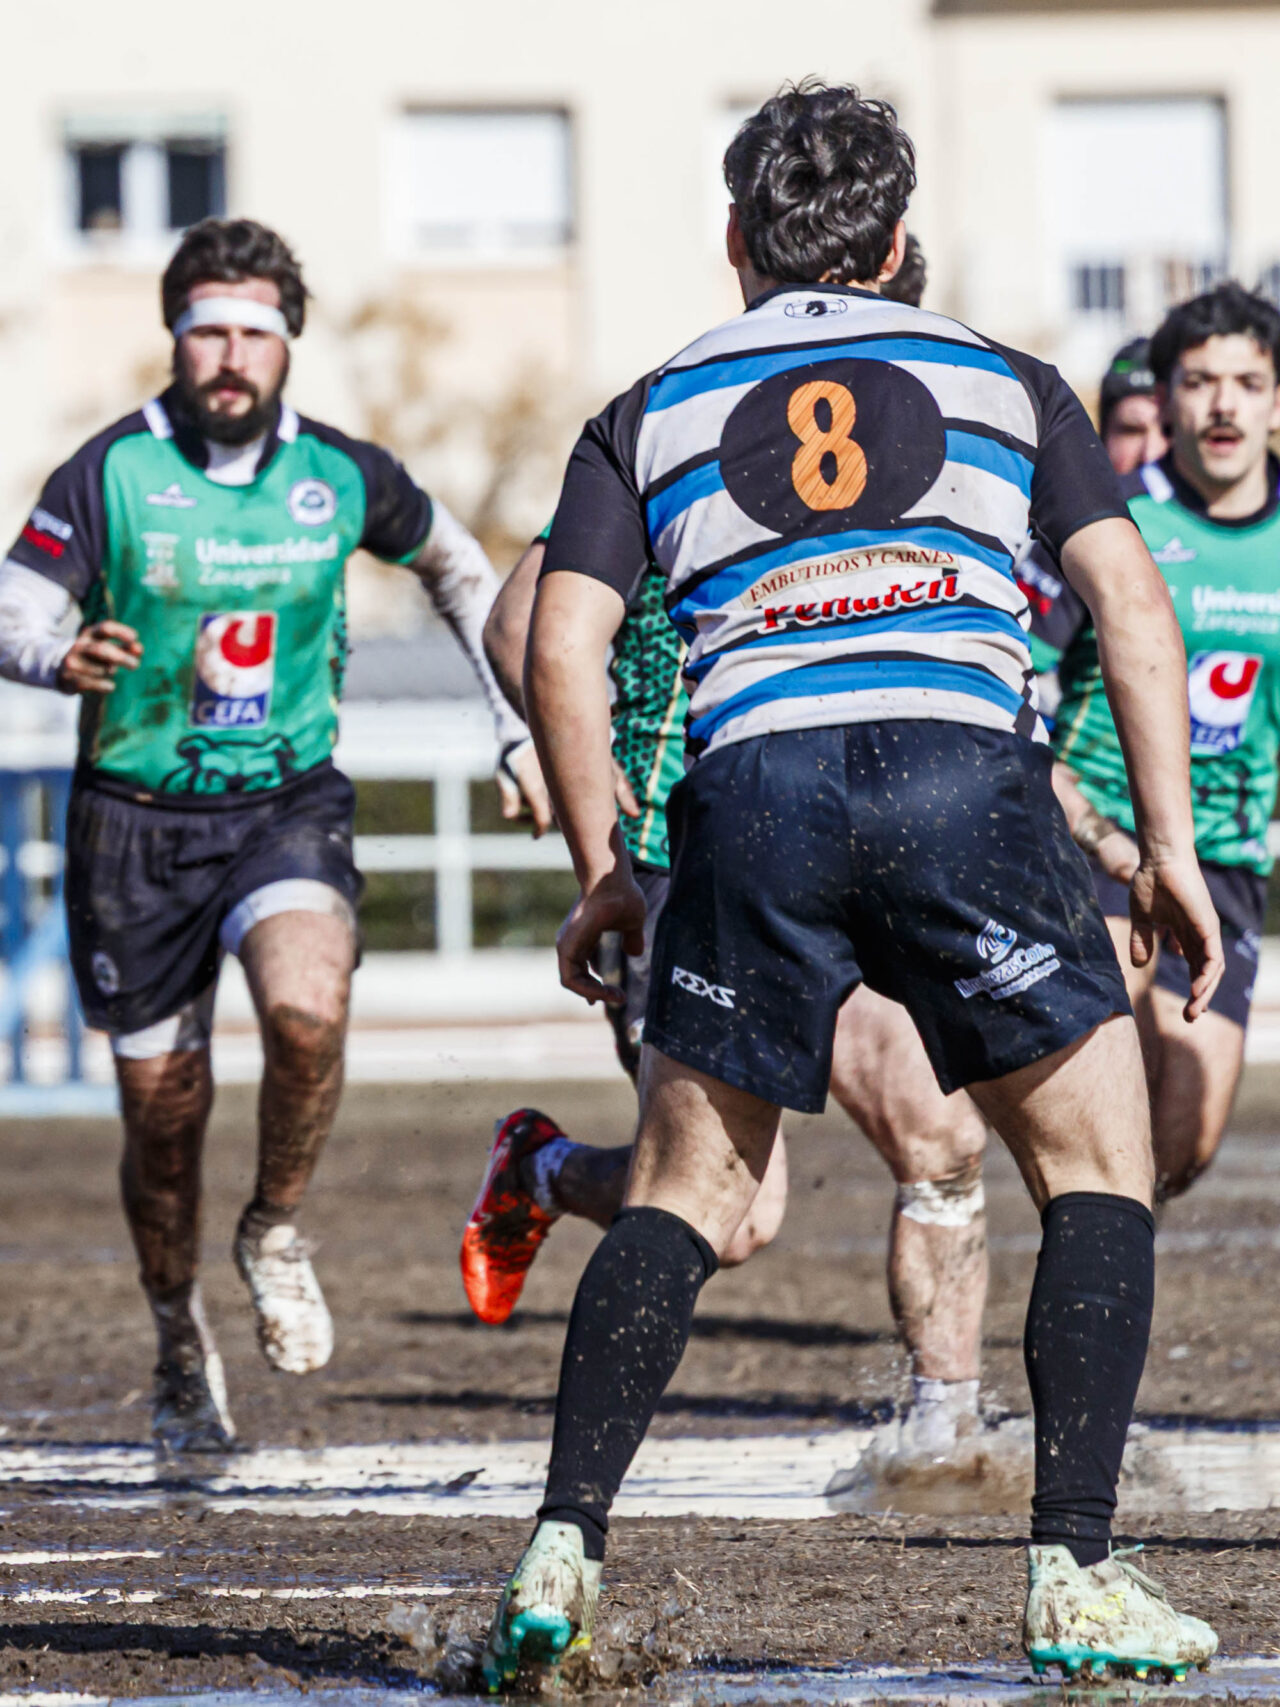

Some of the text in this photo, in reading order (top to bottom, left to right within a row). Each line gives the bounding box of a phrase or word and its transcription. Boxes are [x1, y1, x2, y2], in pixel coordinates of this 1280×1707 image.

[787, 380, 868, 511] 8
[195, 533, 339, 565] Universidad
[749, 549, 955, 603] EMBUTIDOS Y CARNES
[196, 699, 262, 725] CEFA
